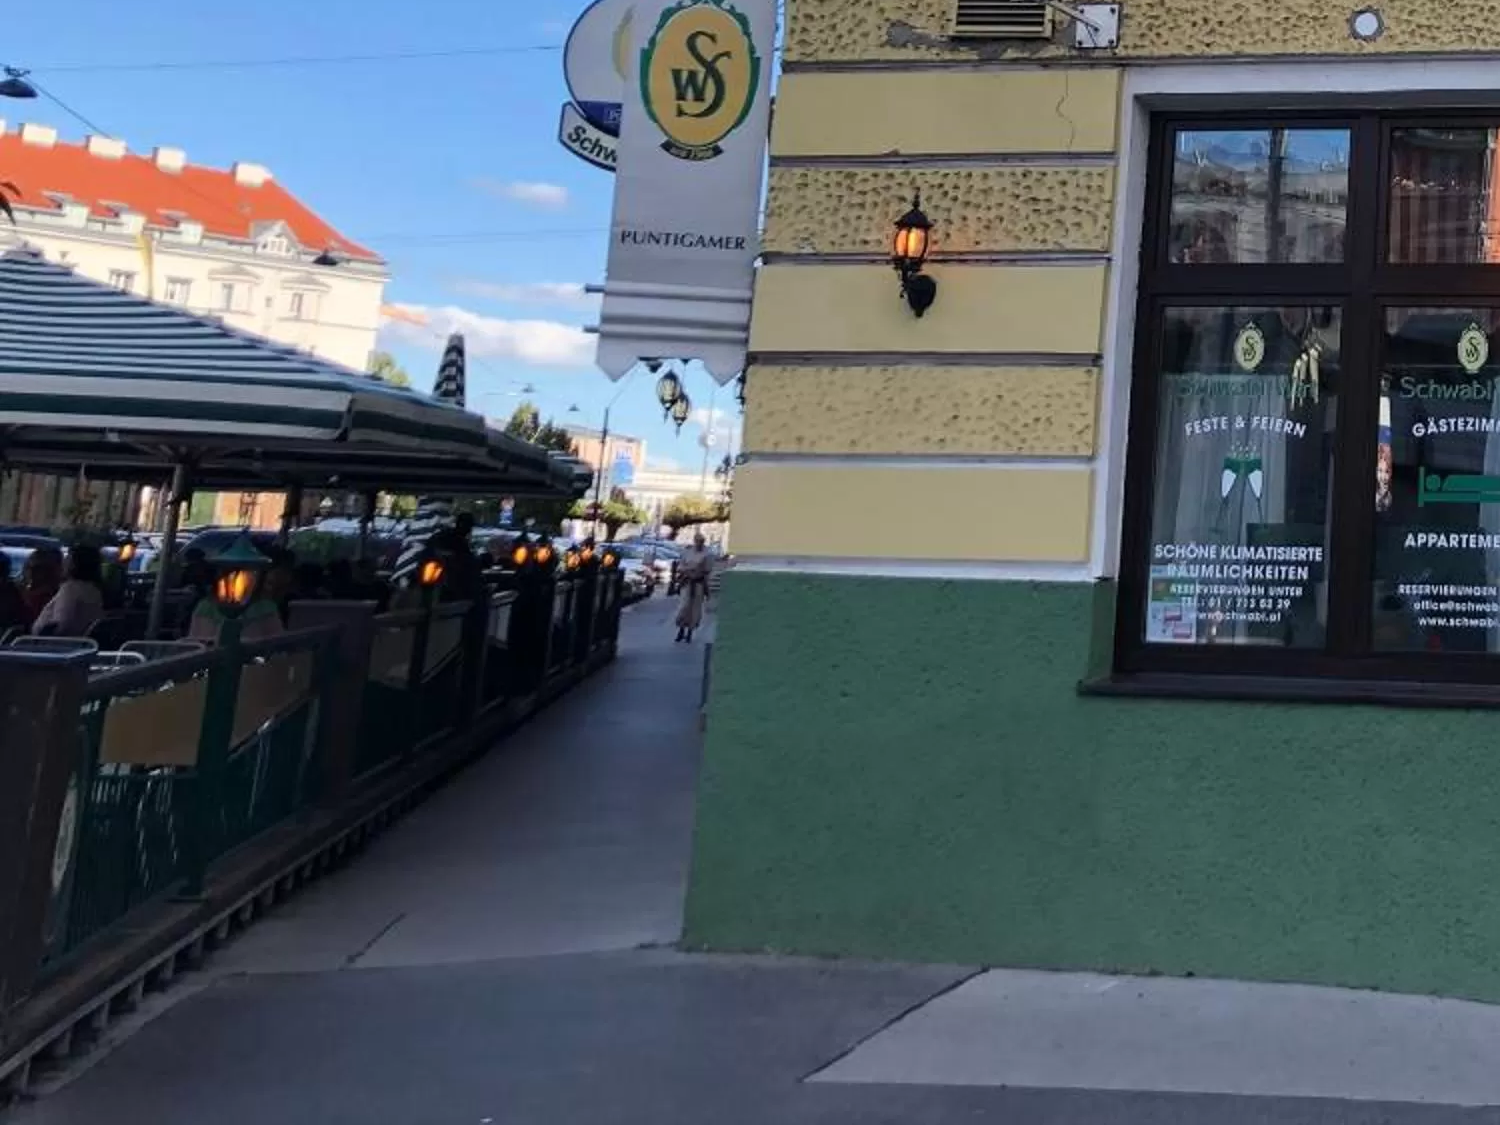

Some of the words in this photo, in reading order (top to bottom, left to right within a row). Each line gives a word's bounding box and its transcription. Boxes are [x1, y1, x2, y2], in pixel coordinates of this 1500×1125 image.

[567, 125, 617, 163] Schw
[620, 230, 746, 251] PUNTIGAMER
[1400, 376, 1492, 399] Schwabl
[1184, 416, 1229, 436] FESTE
[1235, 415, 1246, 429] &
[1252, 416, 1307, 438] FEIERN
[1155, 542, 1217, 560] SCHÖNE
[1221, 546, 1323, 561] KLIMATISIERTE
[1167, 561, 1309, 580] RÄUMLICHKEITEN
[1269, 585, 1304, 597] UNTER
[1398, 583, 1497, 597] RESERVIERUNGEN
